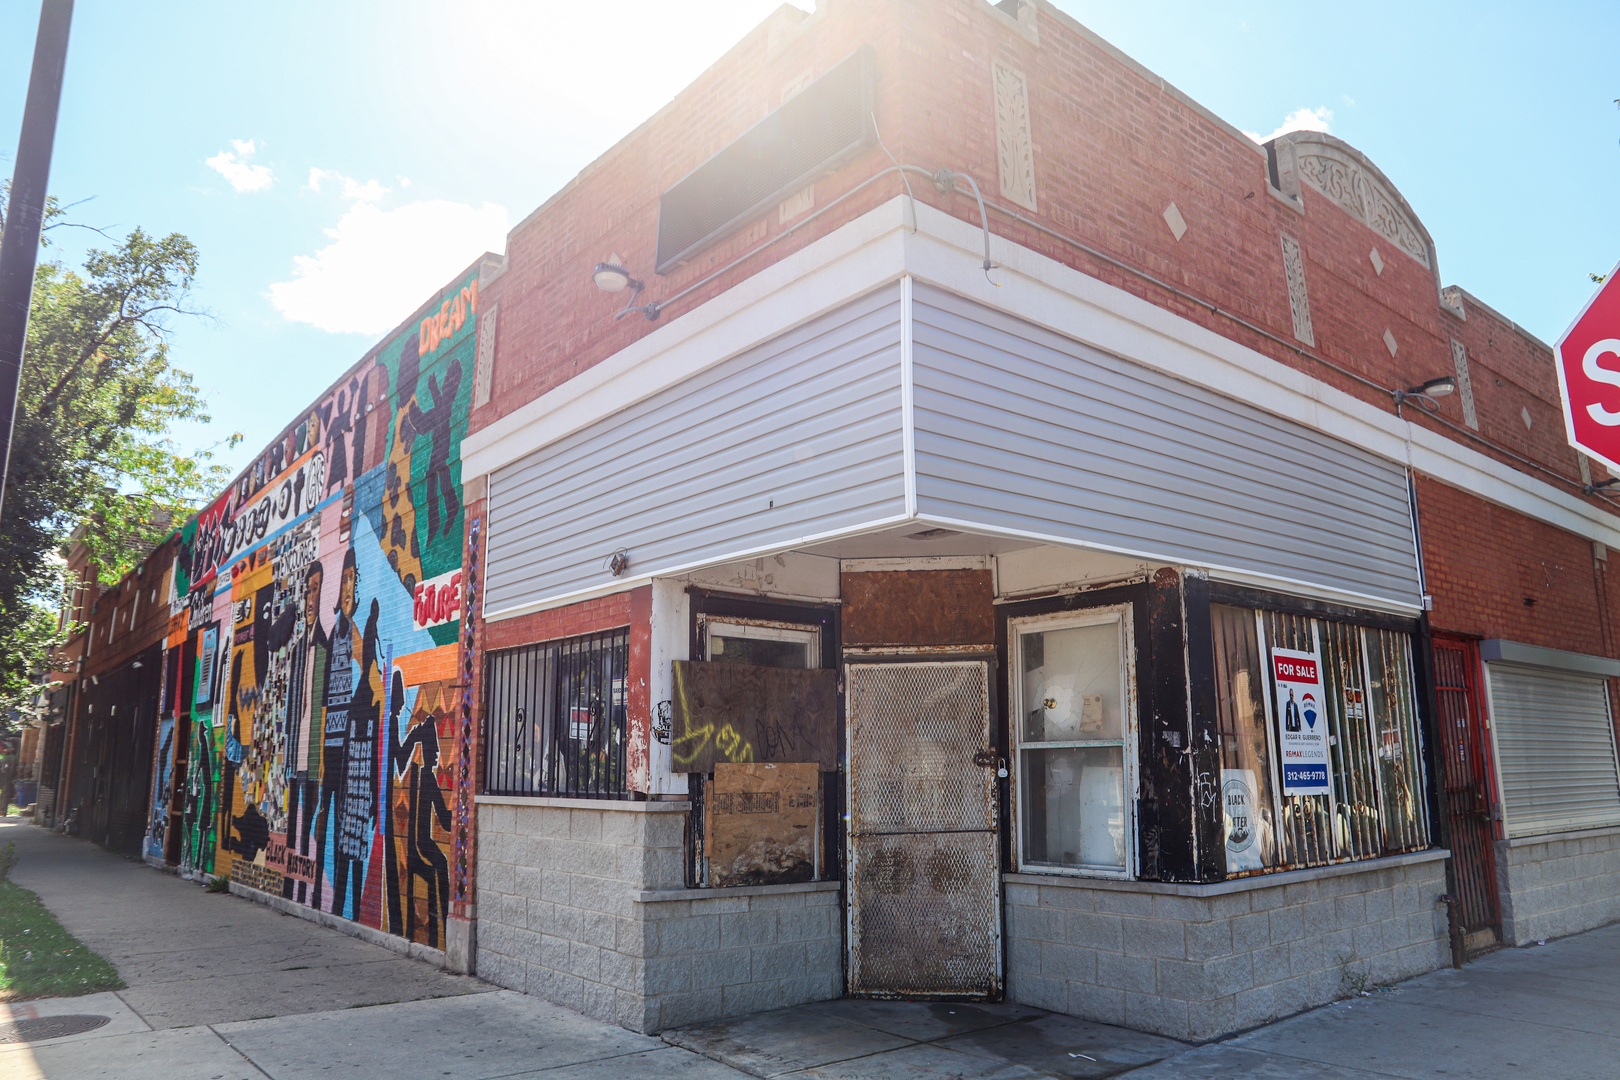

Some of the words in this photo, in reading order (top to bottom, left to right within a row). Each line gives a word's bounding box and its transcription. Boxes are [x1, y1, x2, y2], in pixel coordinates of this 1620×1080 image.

[418, 278, 478, 357] DREAM
[413, 572, 462, 627] FUTURE
[1277, 662, 1295, 676] FOR
[1296, 665, 1315, 678] SALE
[1227, 794, 1245, 806] BLACK
[266, 839, 287, 865] BLACK
[287, 852, 316, 880] HISTORY
